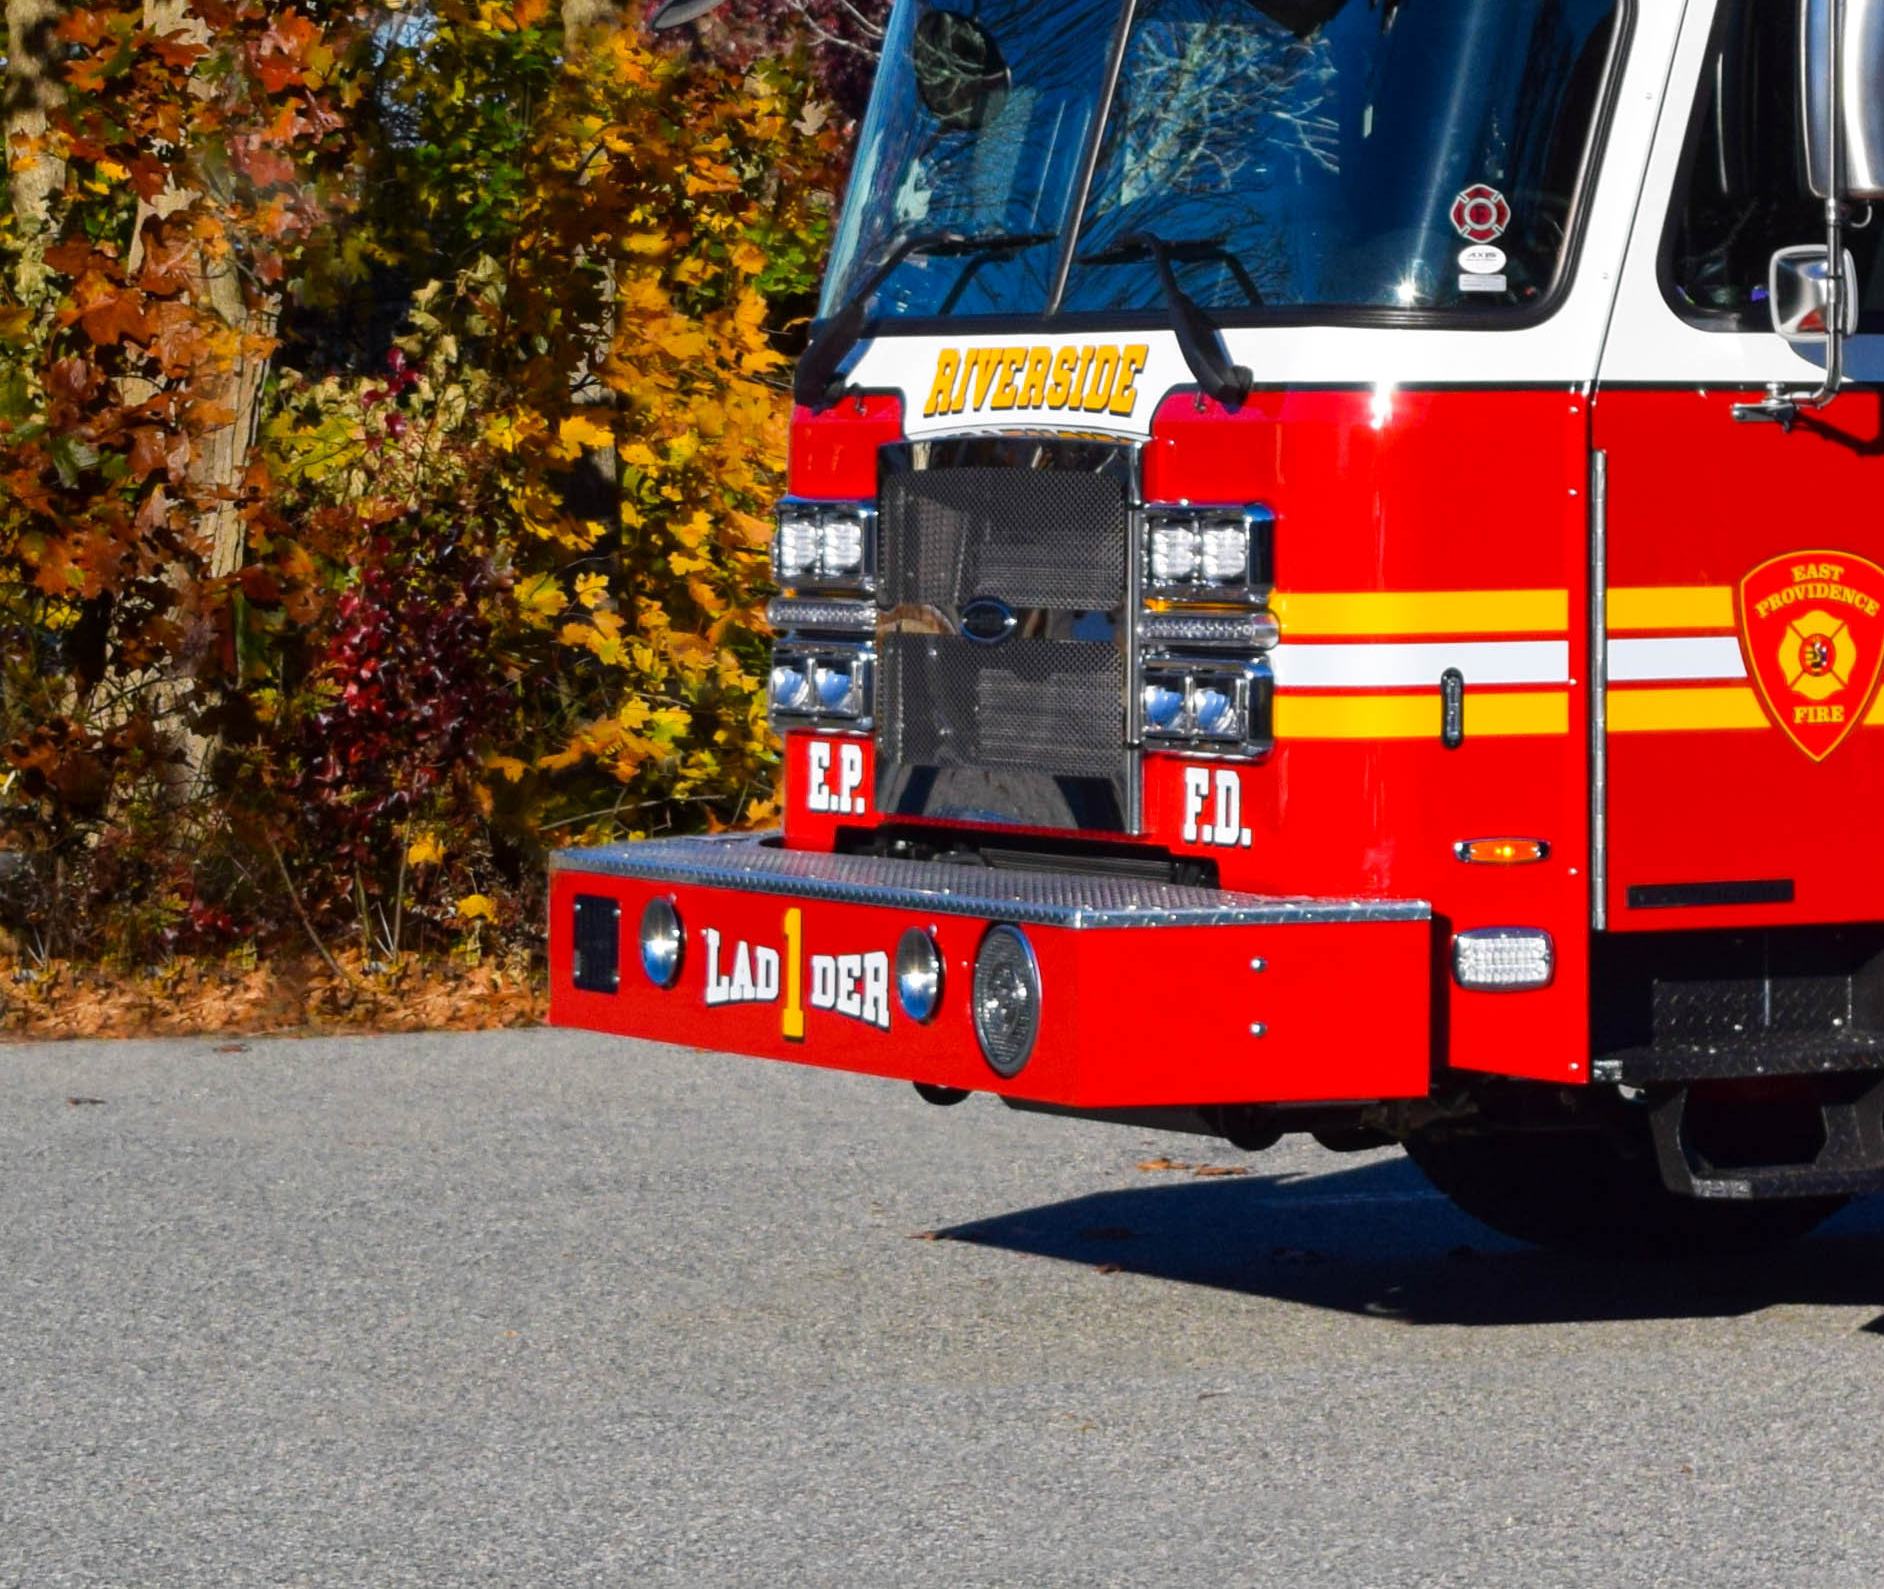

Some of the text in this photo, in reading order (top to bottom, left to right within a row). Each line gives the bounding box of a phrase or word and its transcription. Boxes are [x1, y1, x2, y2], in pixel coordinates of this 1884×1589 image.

[923, 344, 1149, 418] RIVERSIDE
[1754, 582, 1881, 619] PROVIDENCE
[1790, 563, 1845, 583] EAST
[1793, 705, 1845, 724] FIRE
[806, 741, 865, 815] E.P.
[1182, 766, 1252, 848] F.D.
